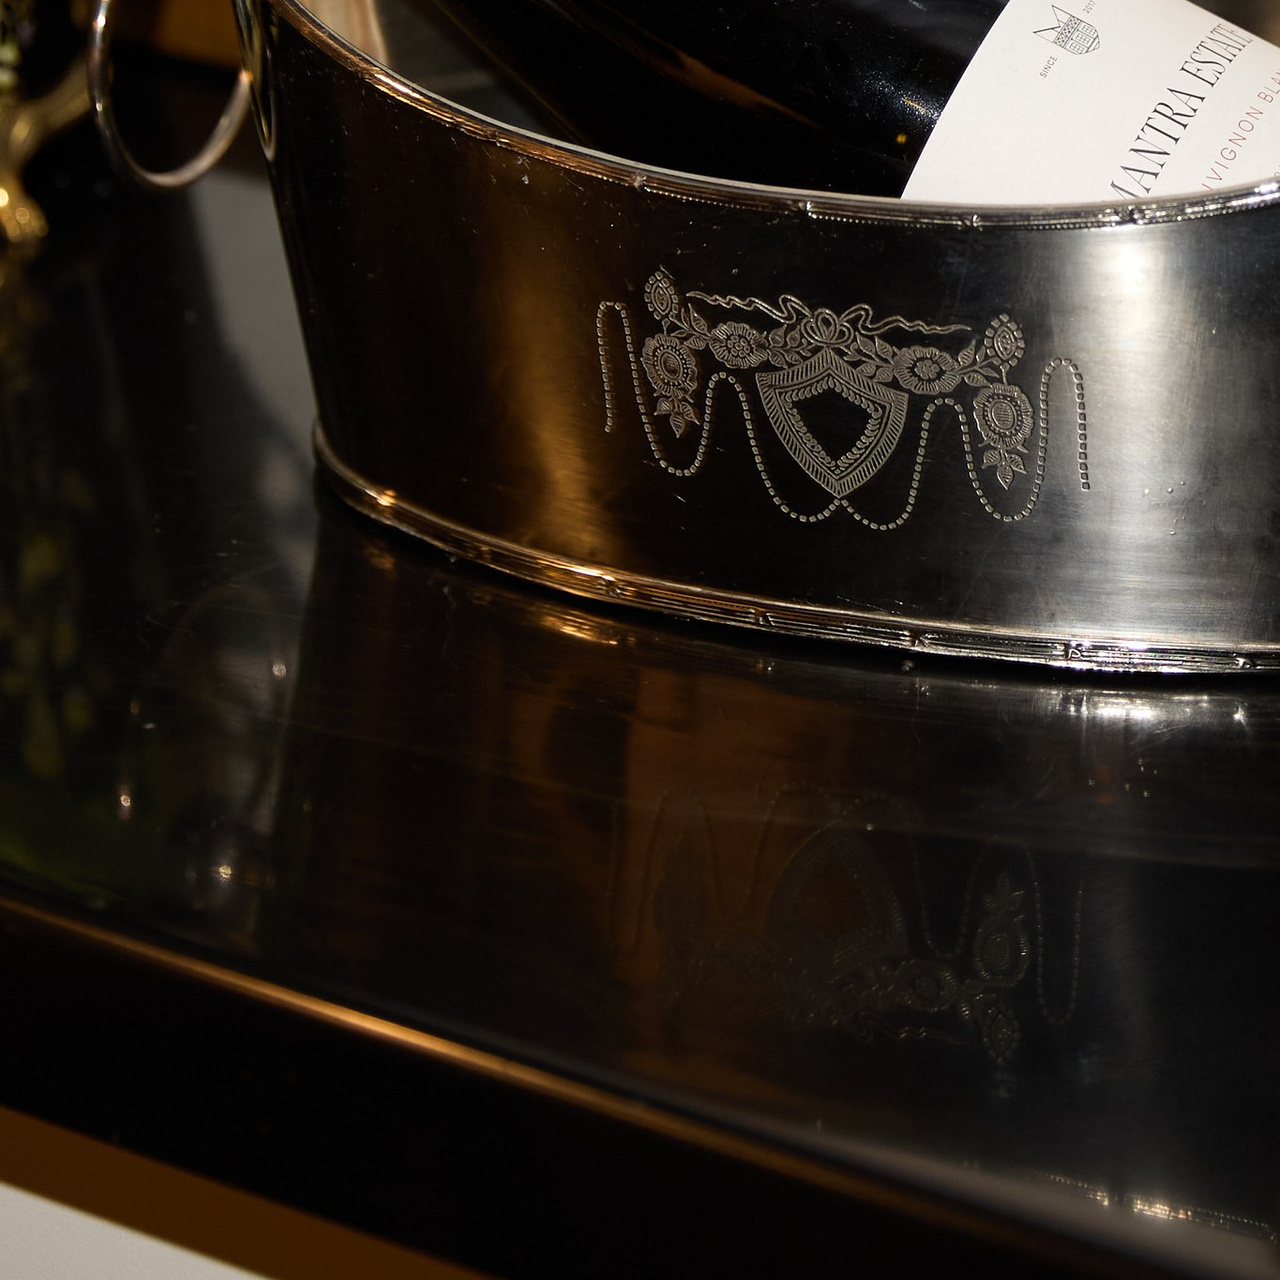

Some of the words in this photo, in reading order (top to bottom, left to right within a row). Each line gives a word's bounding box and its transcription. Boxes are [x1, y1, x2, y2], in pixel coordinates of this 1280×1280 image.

[1039, 55, 1058, 79] SINCE
[1082, 0, 1096, 14] 2017
[1179, 23, 1254, 88] ESTATE
